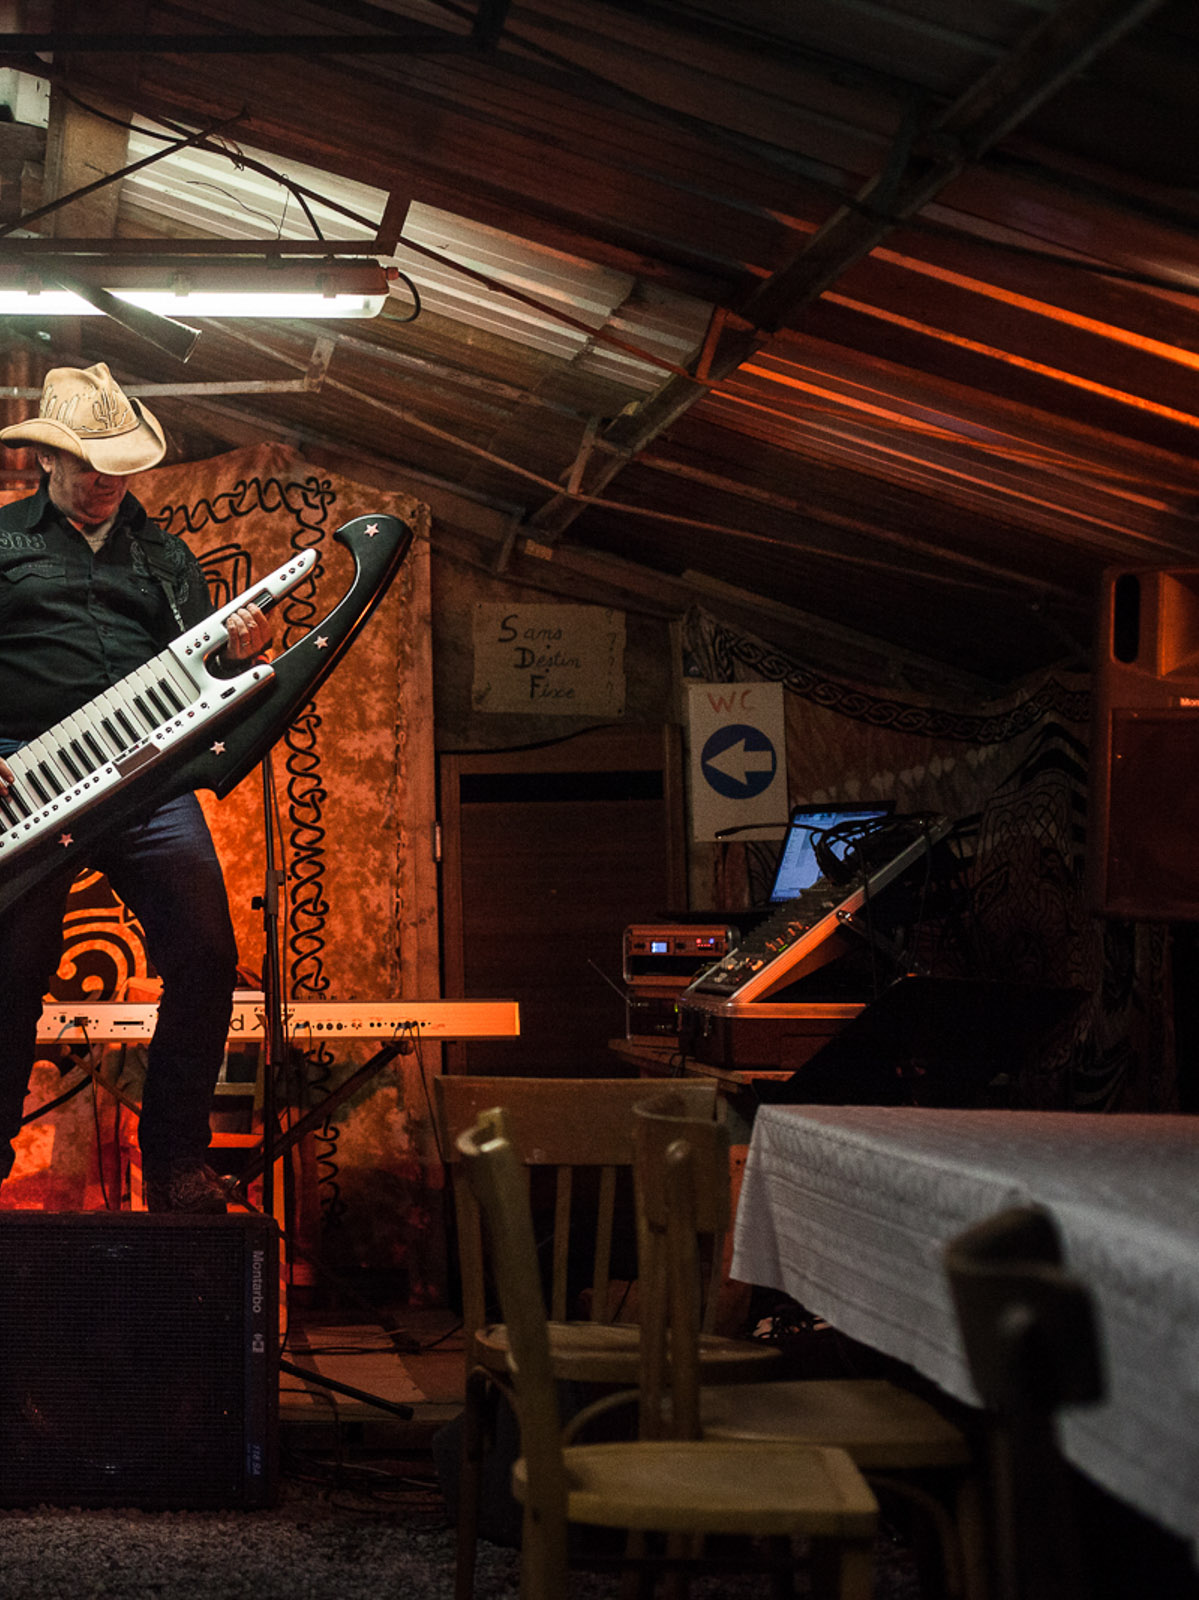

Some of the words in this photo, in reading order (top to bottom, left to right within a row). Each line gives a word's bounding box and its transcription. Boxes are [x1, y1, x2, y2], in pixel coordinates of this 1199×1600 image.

[498, 614, 563, 642] Sans
[514, 647, 581, 669] Destin
[707, 688, 754, 713] WC
[252, 1249, 264, 1314] Montarbo
